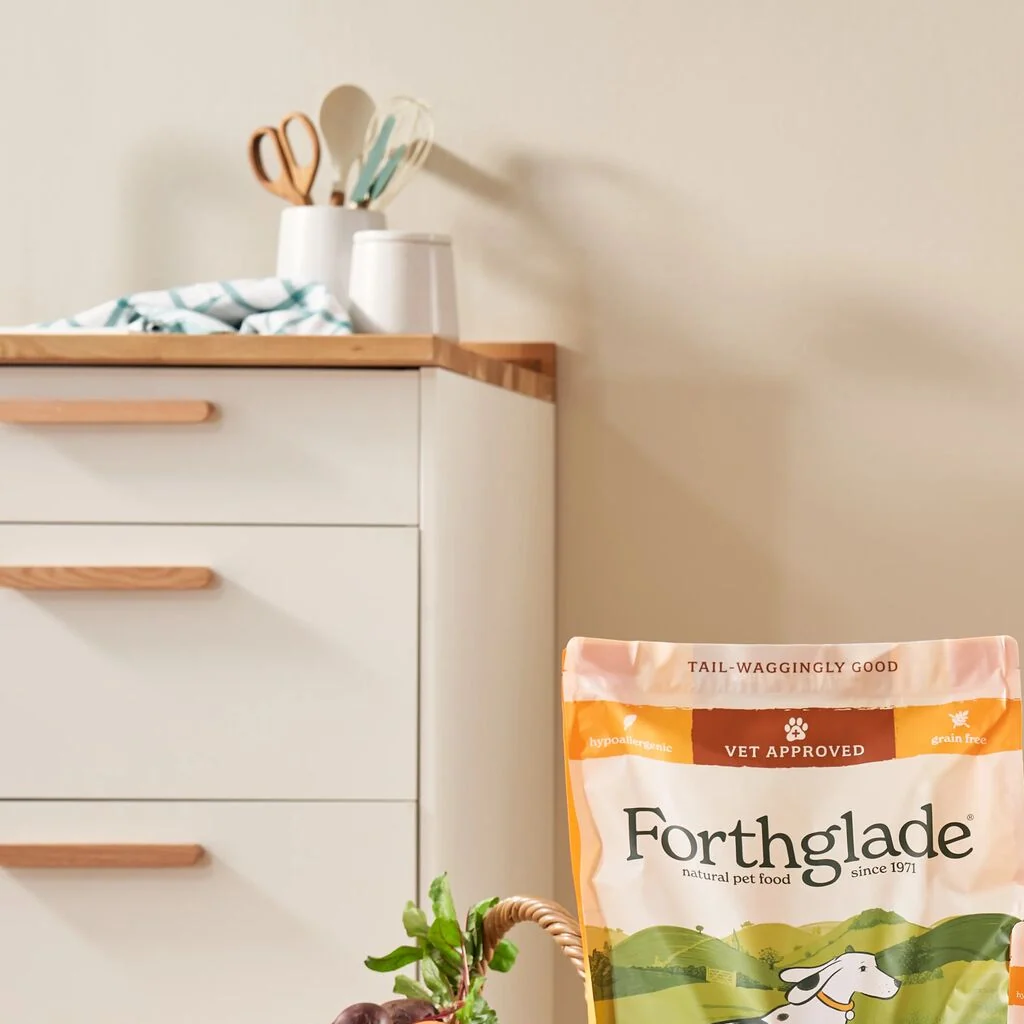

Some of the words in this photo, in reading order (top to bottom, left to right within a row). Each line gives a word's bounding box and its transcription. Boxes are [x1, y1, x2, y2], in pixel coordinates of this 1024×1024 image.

[687, 660, 845, 674] TAIL-WAGGINGLY
[851, 660, 899, 673] GOOD
[589, 734, 673, 754] hypoallergenic
[931, 732, 962, 746] grain
[964, 732, 988, 745] free
[725, 745, 759, 758] VET
[766, 744, 865, 758] APPROVED
[622, 803, 974, 888] Forthglade
[682, 867, 730, 884] natural
[732, 872, 757, 886] pet
[759, 872, 792, 885] food
[851, 865, 888, 878] since
[890, 862, 917, 875] 1971
